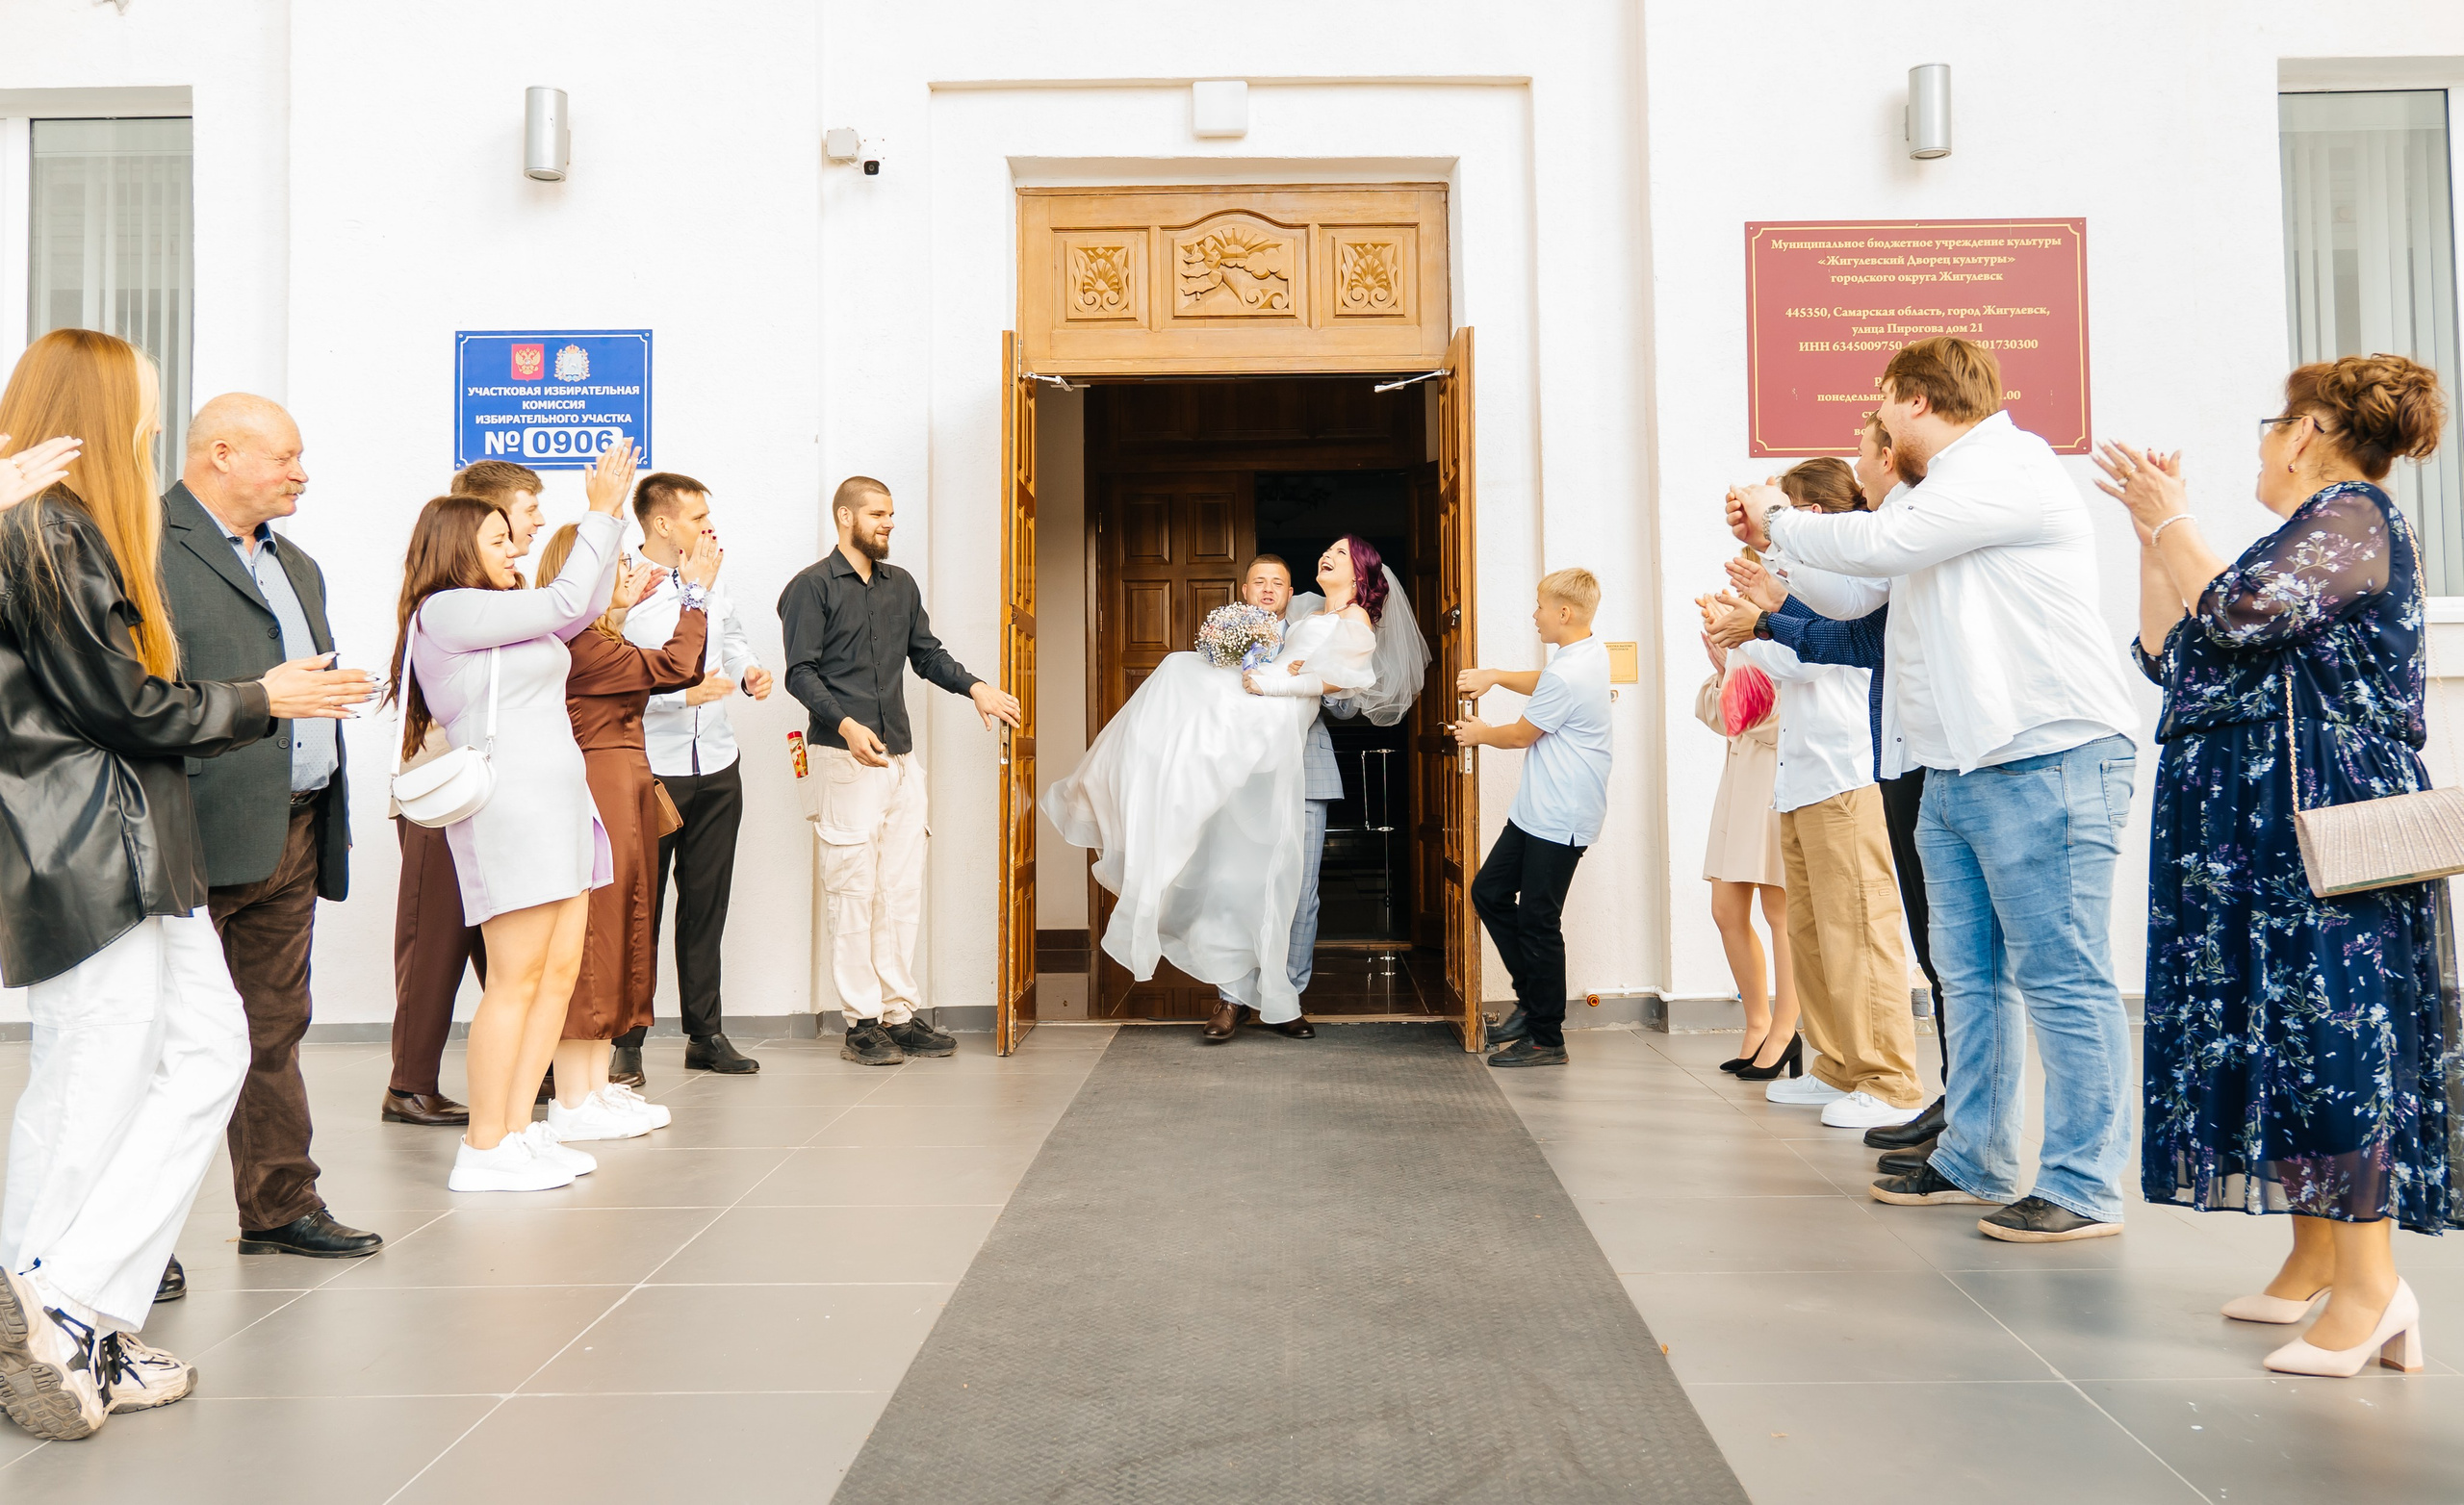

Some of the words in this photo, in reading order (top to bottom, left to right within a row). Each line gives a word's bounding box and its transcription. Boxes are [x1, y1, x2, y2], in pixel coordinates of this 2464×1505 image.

[1771, 240, 1864, 251] Муниципальное
[1867, 238, 1933, 248] бюджетное
[1935, 240, 2004, 249] учреждение
[2007, 238, 2061, 248] культуры
[1818, 256, 1905, 268] «Жигулевский
[1907, 255, 1950, 267] Дворец
[1953, 256, 2015, 267] культуры»
[1832, 274, 1895, 285] городского
[1898, 274, 1937, 284] округа
[1938, 271, 2003, 283] Жигулевск
[1785, 308, 1830, 319] 445350,
[1834, 307, 1895, 319] Самарская
[1898, 306, 1945, 317] область,
[1948, 308, 1981, 318] город
[1983, 305, 2049, 318] Жигулевск,
[1852, 326, 1885, 336] улица
[1887, 323, 1943, 336] Пирогова
[1946, 325, 1967, 334] дом
[1970, 323, 1983, 332] 21
[1799, 342, 1830, 351] ИНН
[1973, 340, 2038, 349] 301730300
[468, 387, 541, 395] УЧАСТКОВАЯ
[545, 386, 639, 395] ИЗБИРАТЕЛЬНАЯ
[523, 400, 585, 409] КОМИССИЯ
[1818, 395, 1885, 404] понедельни
[476, 415, 578, 423] ИЗБИРАТЕЛЬНОГО
[581, 414, 631, 422] УЧАСТКА
[533, 430, 613, 453] 0906
